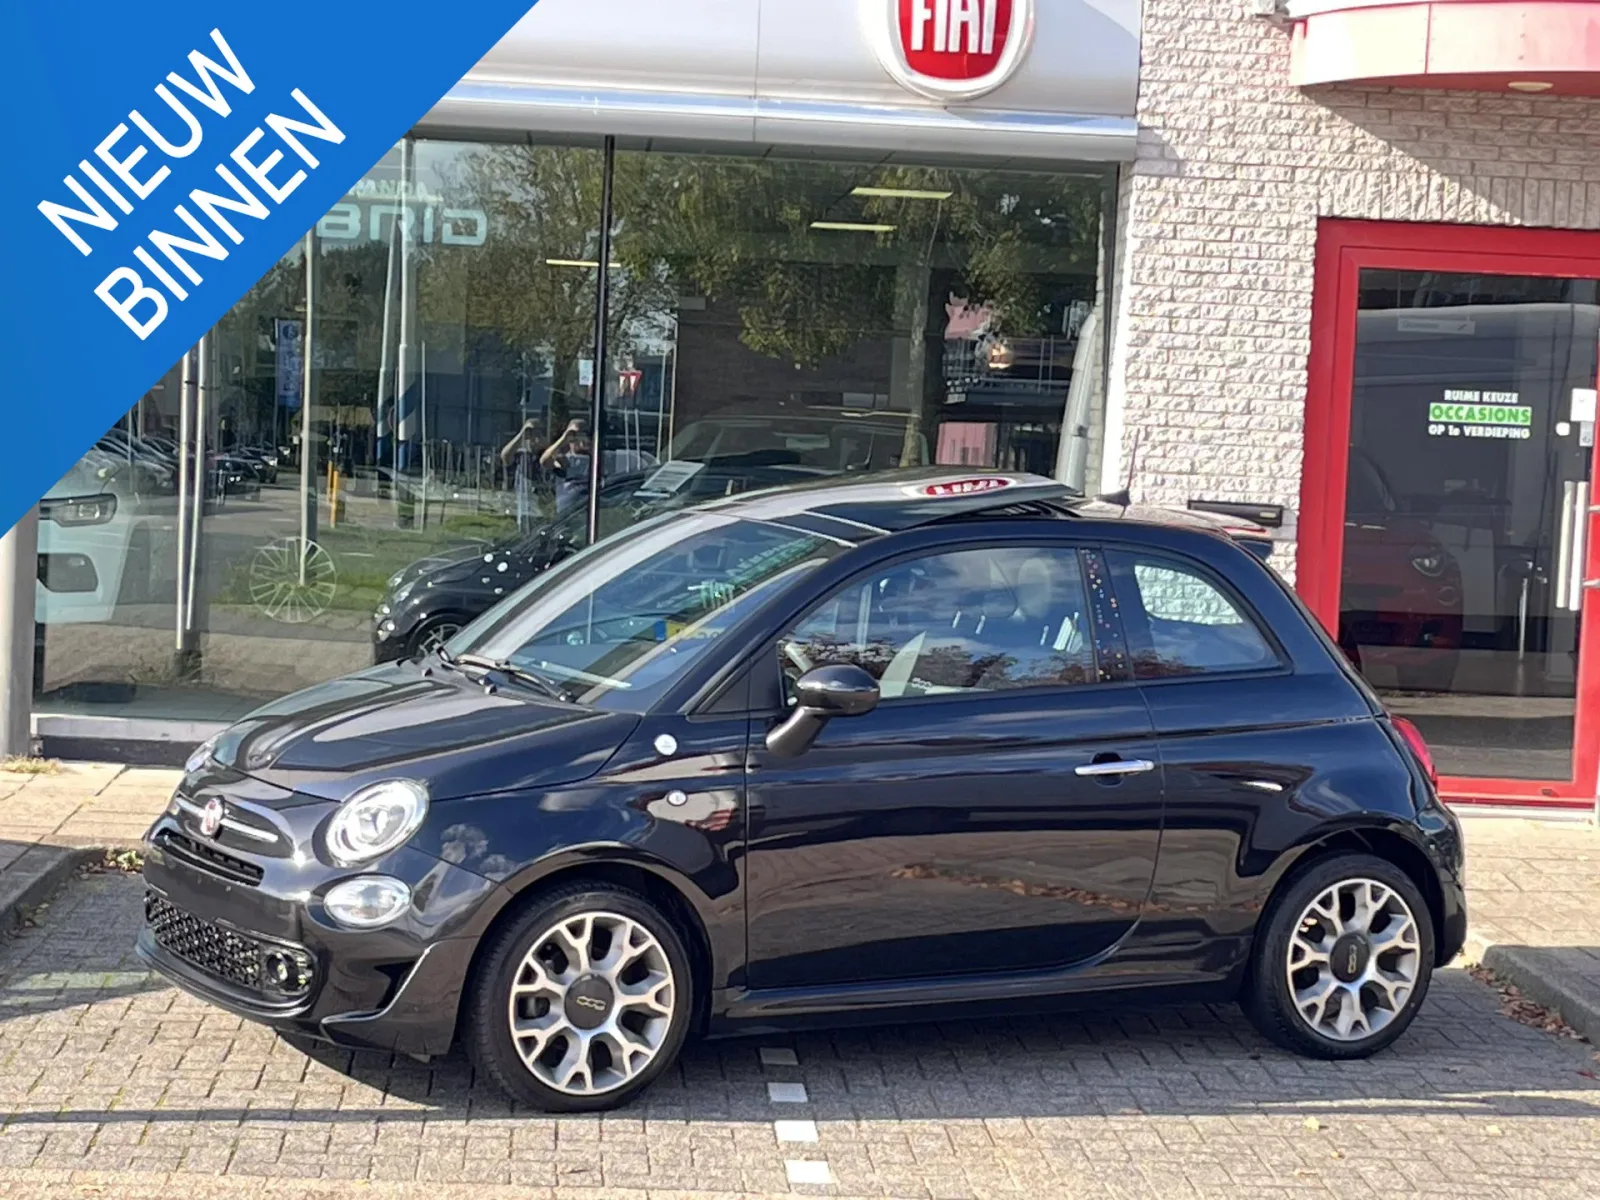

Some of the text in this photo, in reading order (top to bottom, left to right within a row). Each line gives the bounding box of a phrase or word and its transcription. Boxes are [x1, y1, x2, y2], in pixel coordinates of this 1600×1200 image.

[1444, 389, 1519, 404] RUIME KEUZE
[1431, 405, 1530, 423] OCCASIONS
[1428, 424, 1446, 436] OP
[1463, 425, 1531, 439] VERDIEPING
